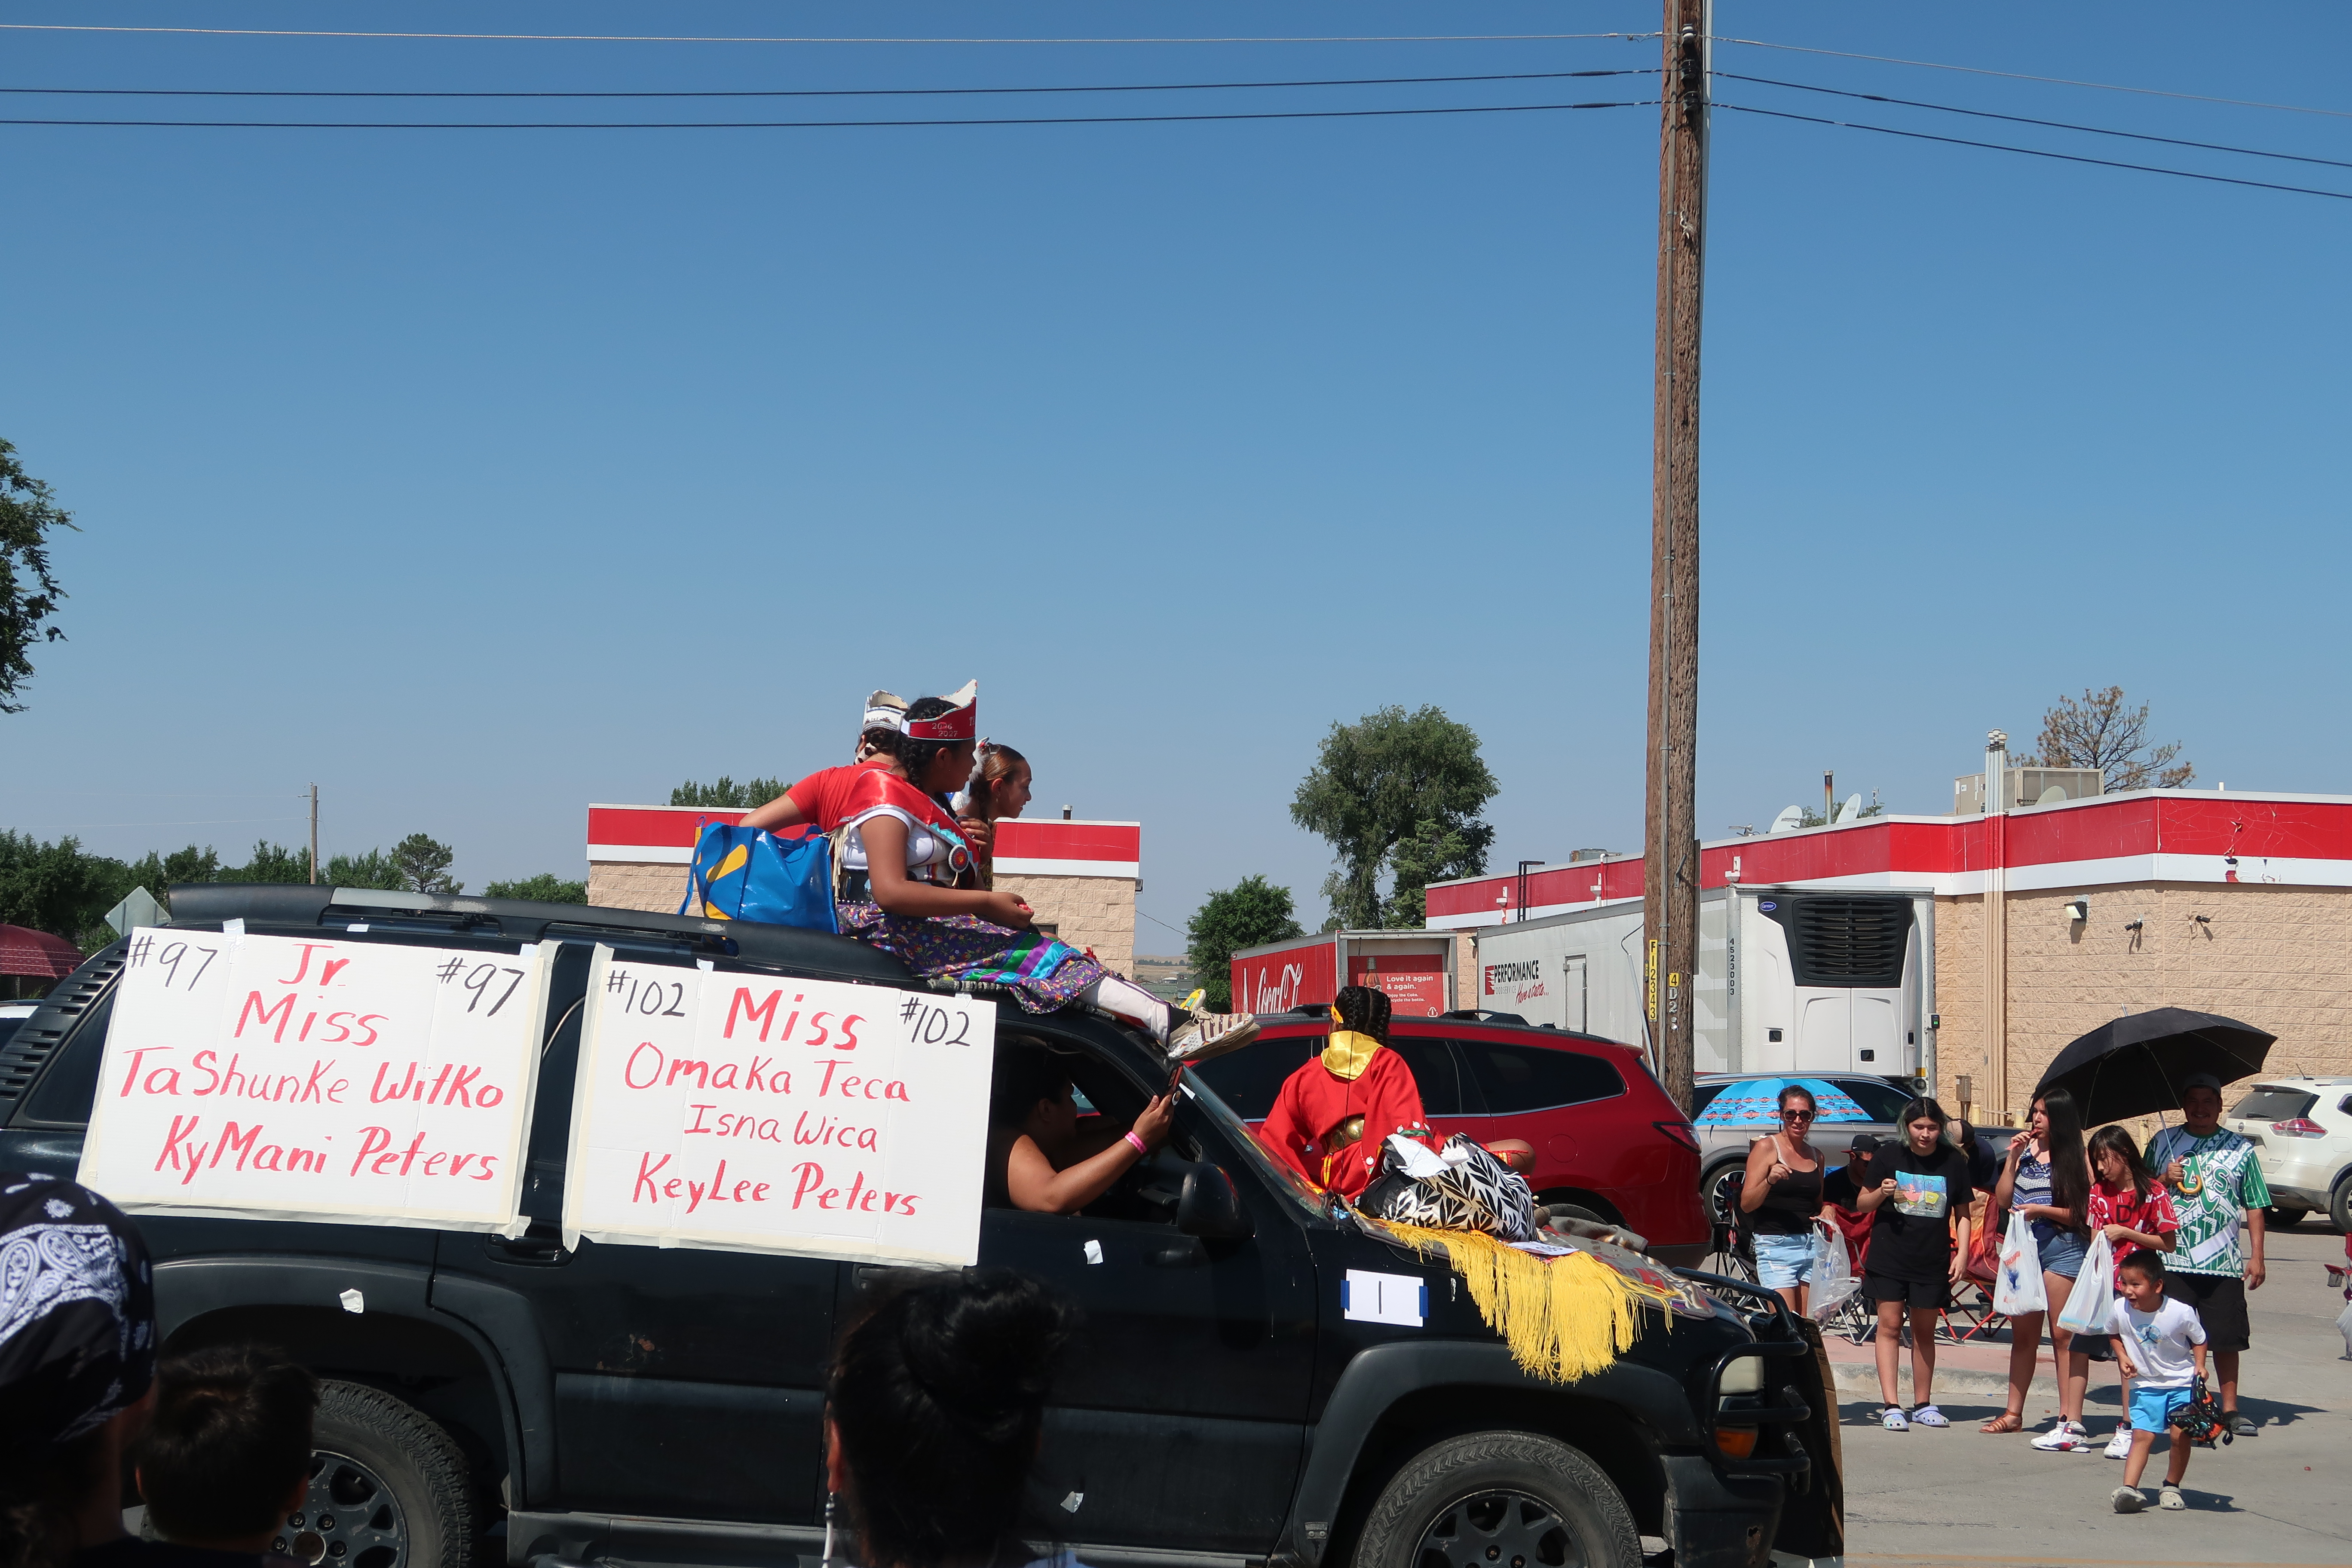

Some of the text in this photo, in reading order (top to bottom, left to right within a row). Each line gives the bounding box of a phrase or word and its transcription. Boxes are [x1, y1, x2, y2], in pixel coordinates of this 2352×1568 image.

[127, 934, 217, 991] #97
[437, 957, 525, 1017] #97
[1413, 974, 1433, 983] again
[1494, 960, 1539, 983] PERFORMANCE
[606, 970, 686, 1017] #102
[1515, 982, 1528, 1006] Have
[234, 990, 389, 1047] Miss
[723, 987, 867, 1051] Miss
[900, 997, 971, 1046] #102
[814, 1059, 910, 1102] Teca
[154, 1115, 499, 1185] KyMani Peters
[684, 1104, 878, 1152] Isna Wica
[632, 1152, 923, 1216] KeyLee Peters
